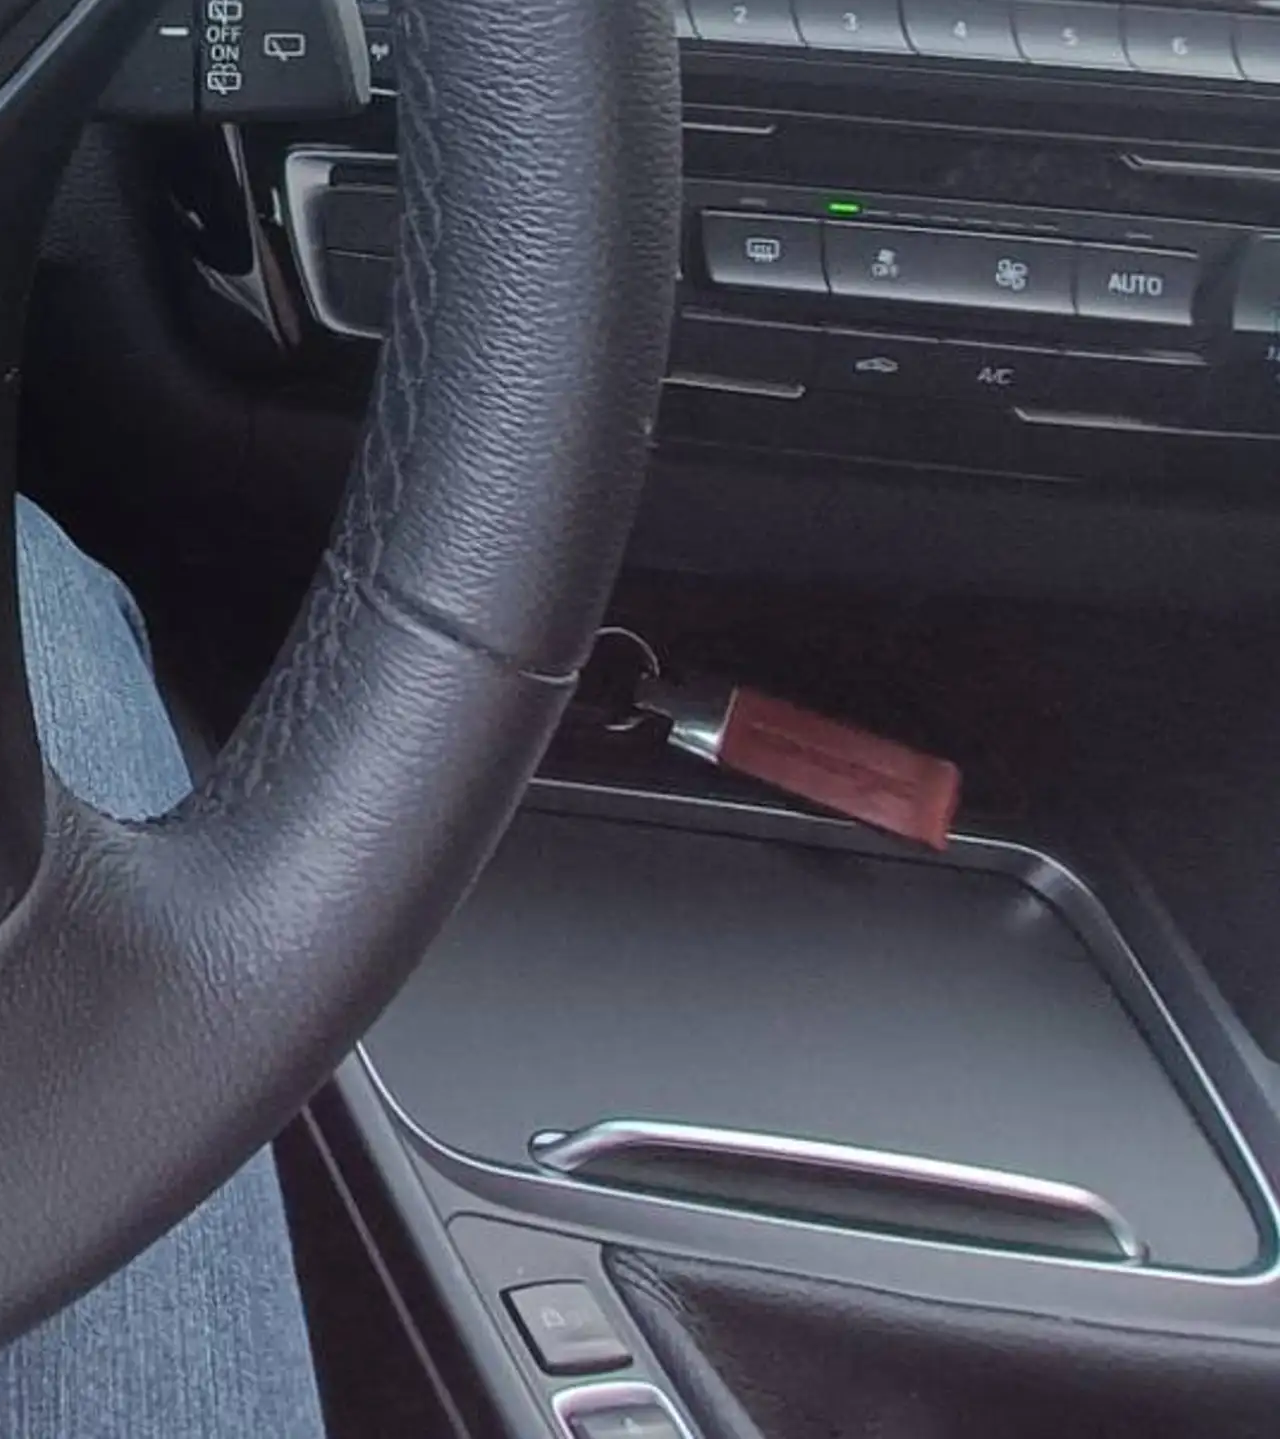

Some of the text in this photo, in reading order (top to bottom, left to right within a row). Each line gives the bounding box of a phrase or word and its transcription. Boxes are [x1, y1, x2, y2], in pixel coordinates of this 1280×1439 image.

[733, 7, 748, 25] 2
[844, 12, 859, 32] 3
[205, 23, 241, 43] OFF
[953, 21, 969, 40] 4
[1063, 28, 1078, 47] 5
[211, 44, 239, 61] ON
[1171, 38, 1189, 57] 6
[1108, 273, 1162, 296] AUTO
[977, 367, 1013, 384] A/C
